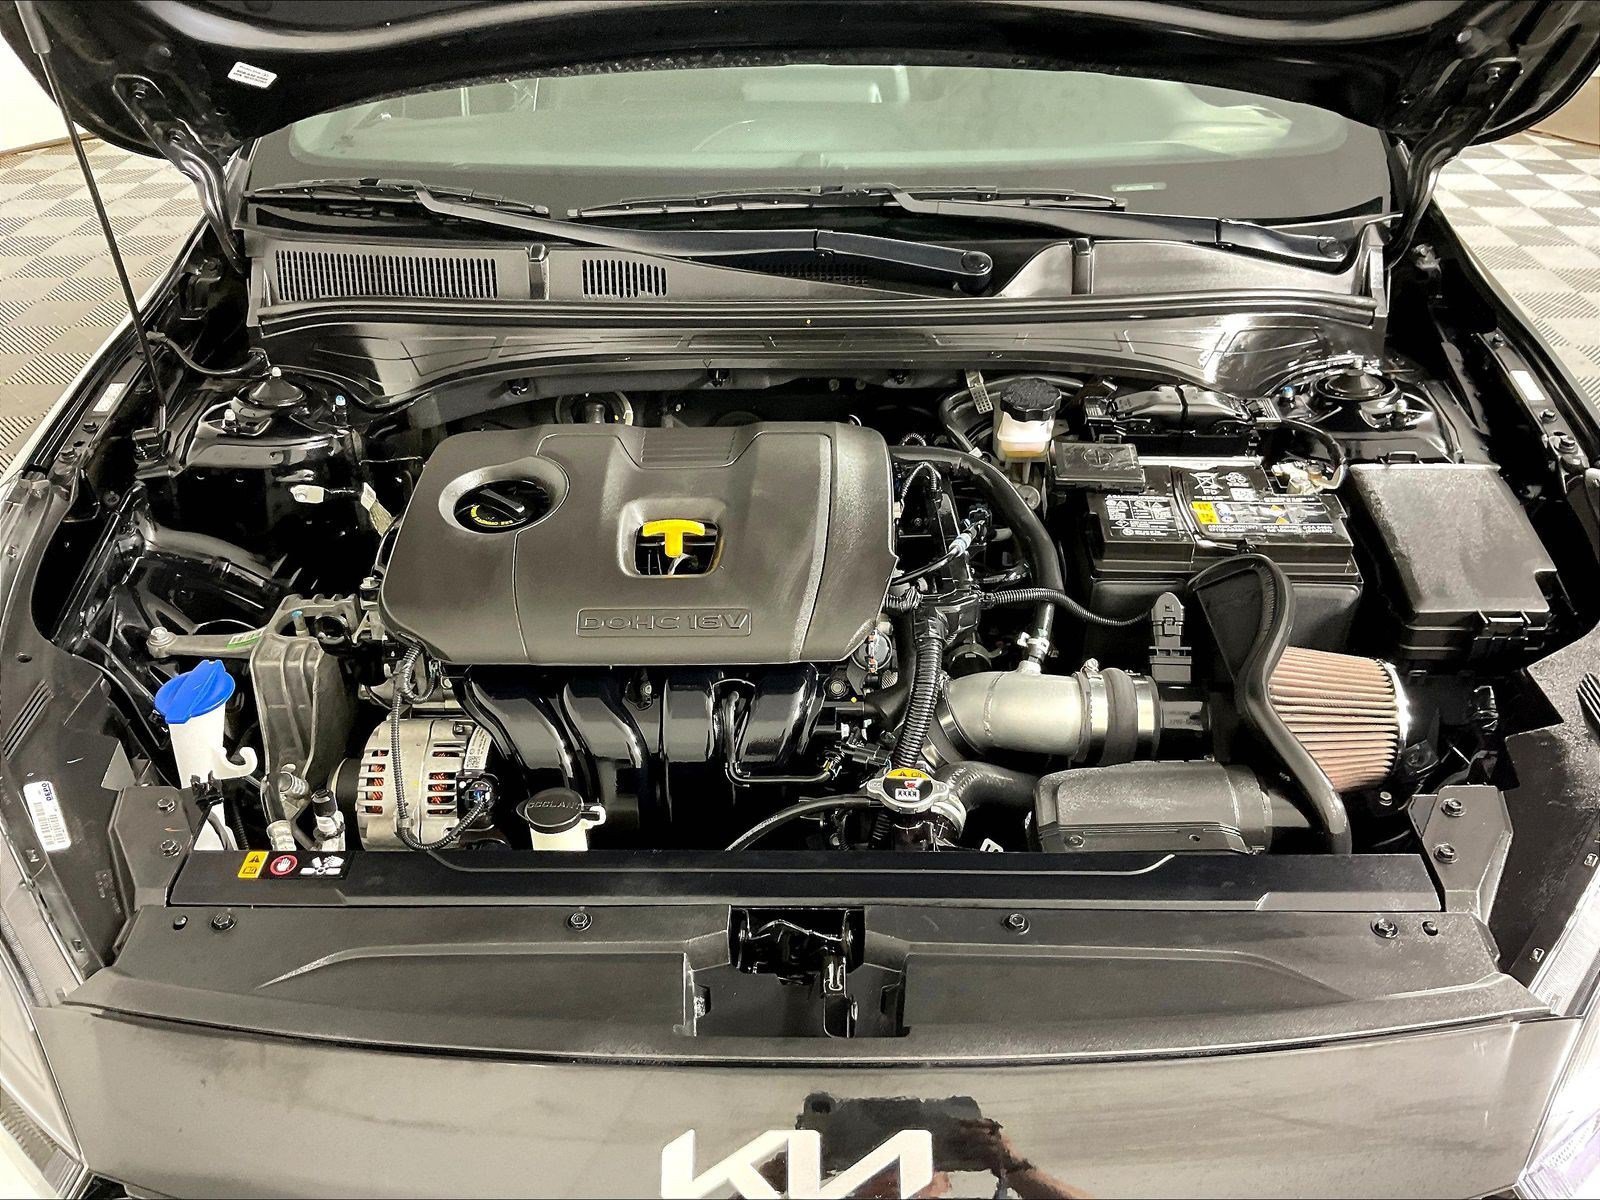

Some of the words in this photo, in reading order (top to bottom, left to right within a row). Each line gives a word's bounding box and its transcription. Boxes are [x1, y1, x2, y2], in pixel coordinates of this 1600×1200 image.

[579, 614, 680, 630] DOHC
[688, 613, 749, 630] 16V
[41, 782, 53, 801] DEPO
